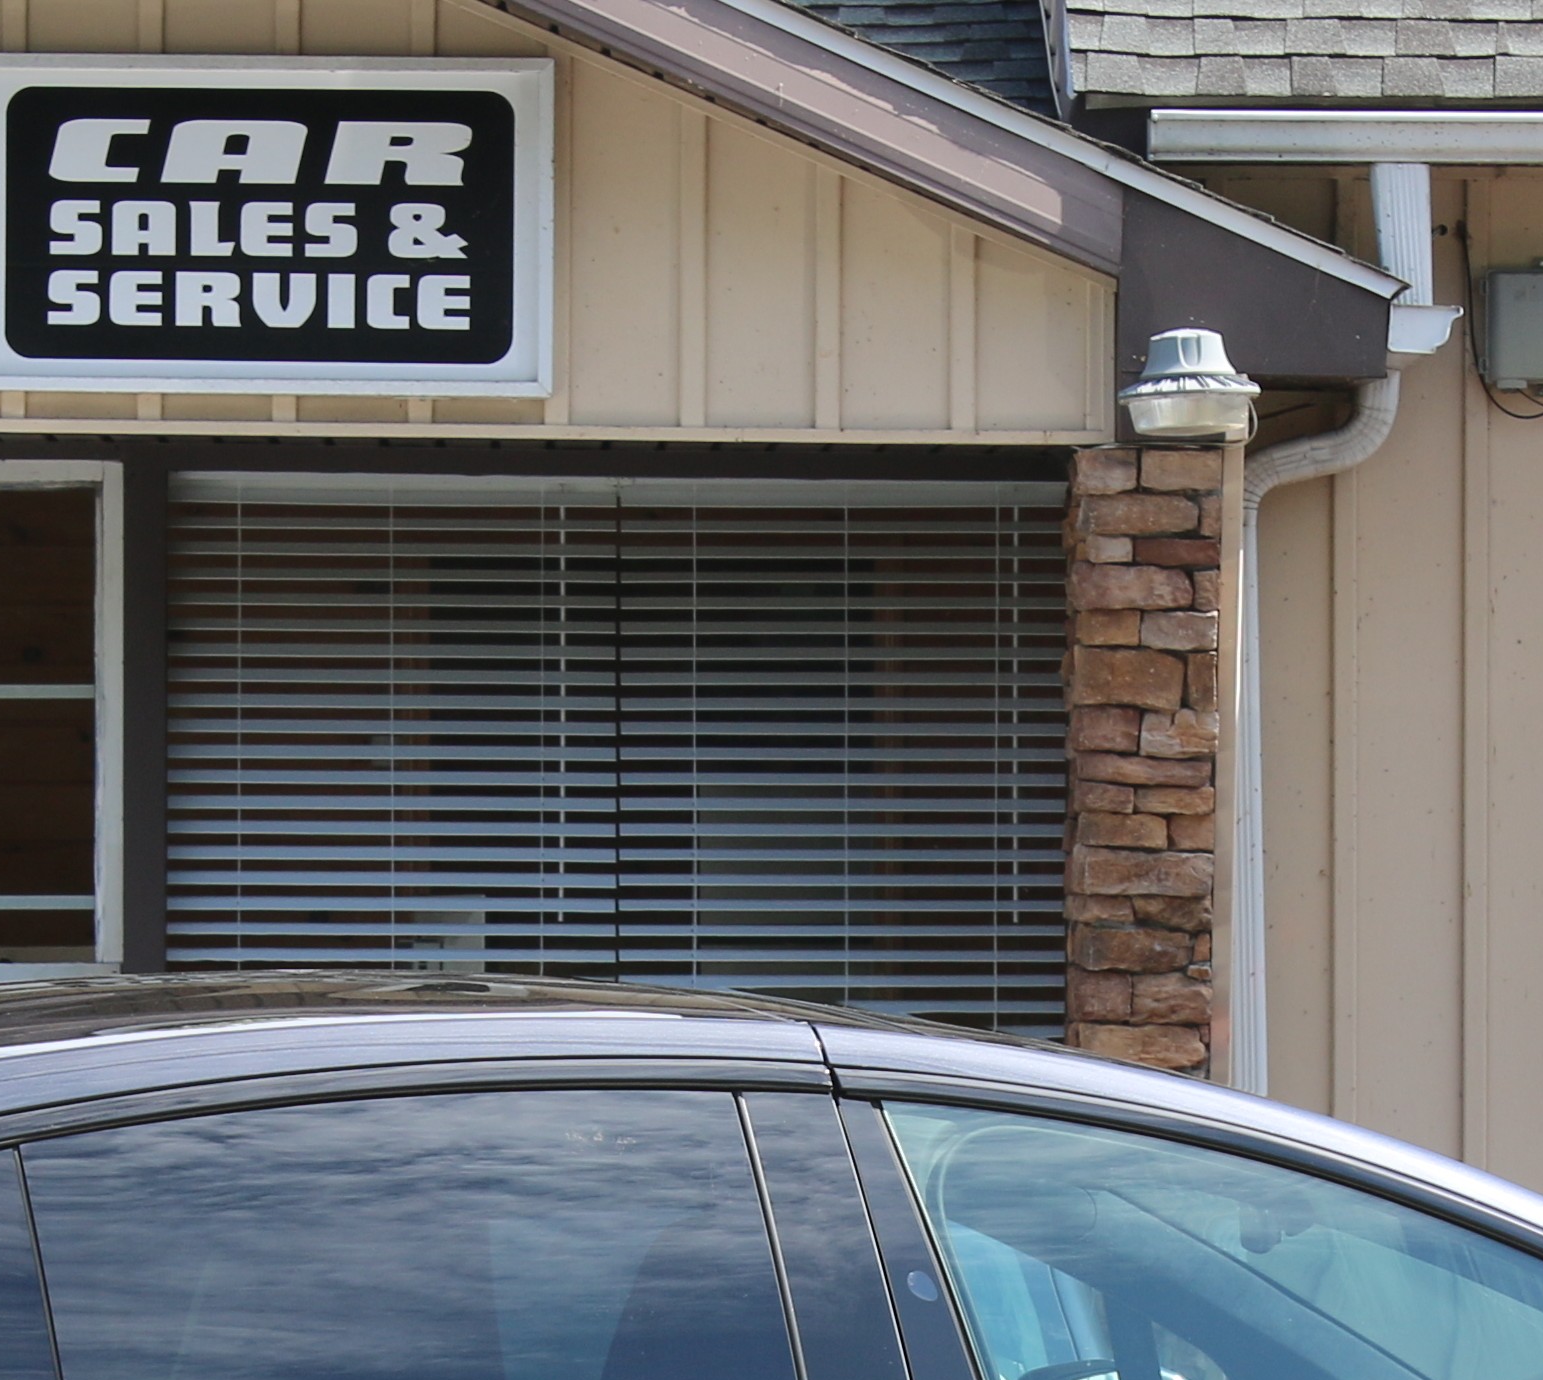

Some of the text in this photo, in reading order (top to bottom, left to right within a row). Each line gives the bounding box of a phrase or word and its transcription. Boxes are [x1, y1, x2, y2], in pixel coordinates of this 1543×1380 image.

[48, 118, 473, 186] CAR
[49, 199, 469, 259] SALES &
[47, 269, 471, 331] SERVICE
